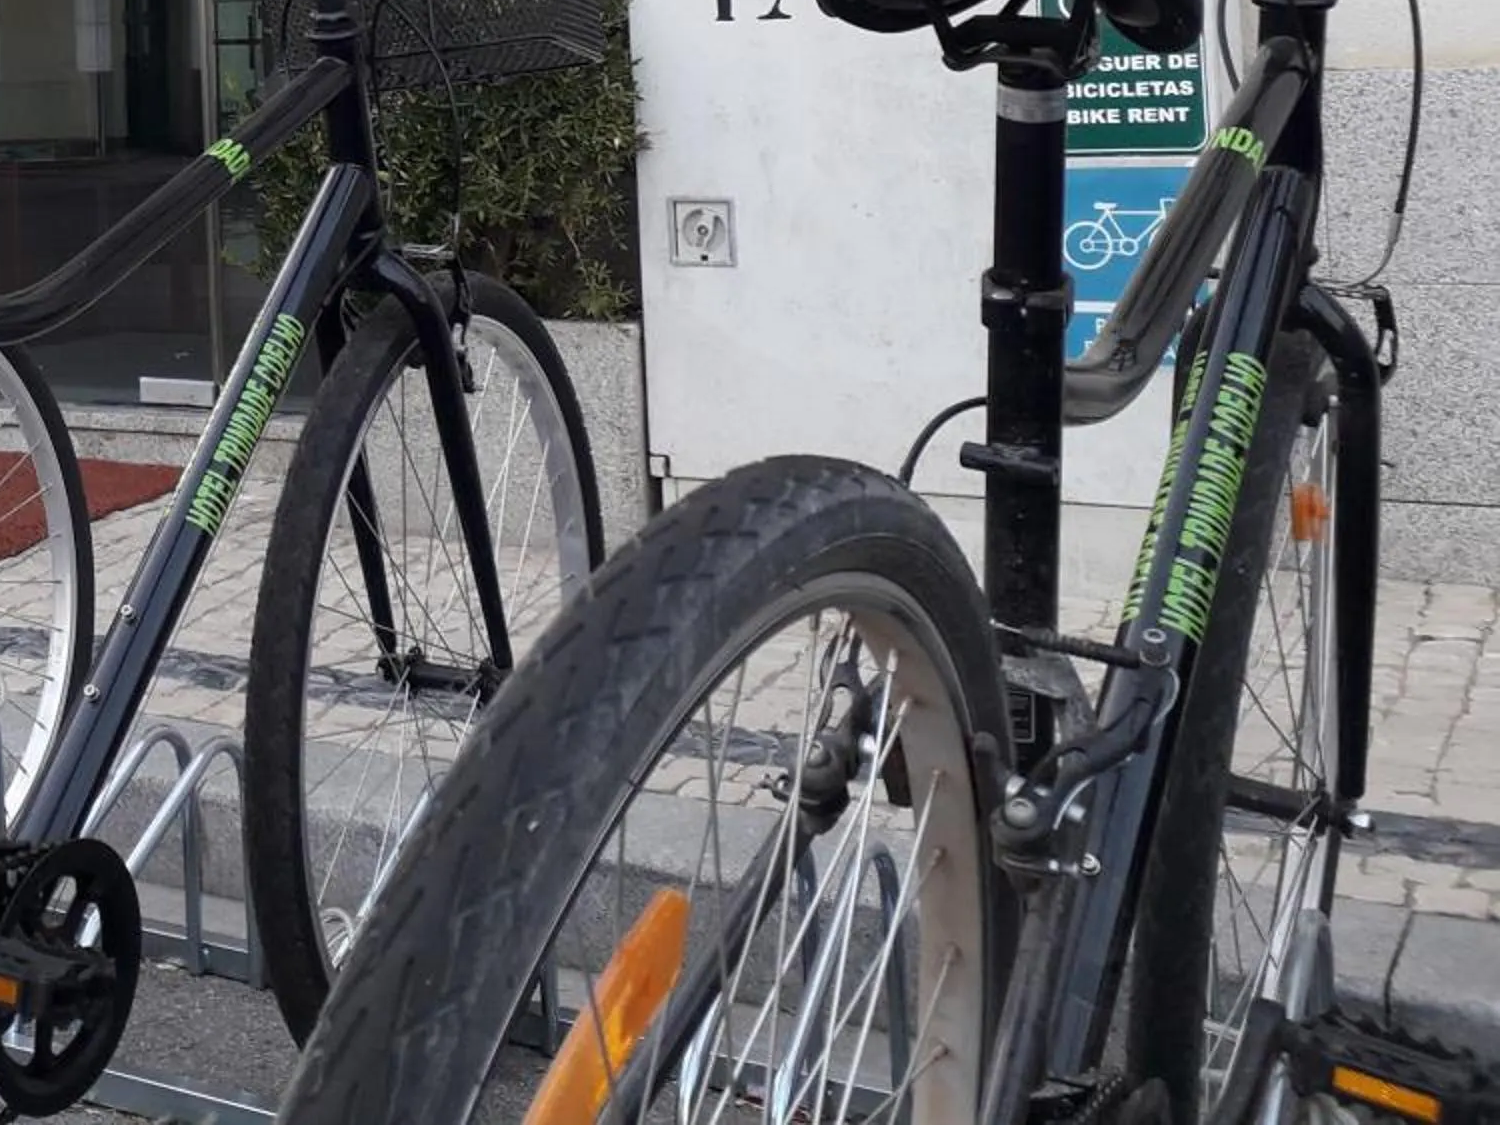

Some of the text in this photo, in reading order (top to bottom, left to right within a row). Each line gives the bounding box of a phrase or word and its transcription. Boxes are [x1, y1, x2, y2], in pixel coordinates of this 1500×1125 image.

[1090, 53, 1199, 71] GUER DE
[1067, 106, 1190, 124] BIKE RENT
[185, 312, 306, 536] HOTEL TRINDADE COELHO
[1208, 351, 1268, 450] COELHO
[1180, 438, 1246, 555] TRINDADE
[1157, 557, 1217, 645] HOTEL
